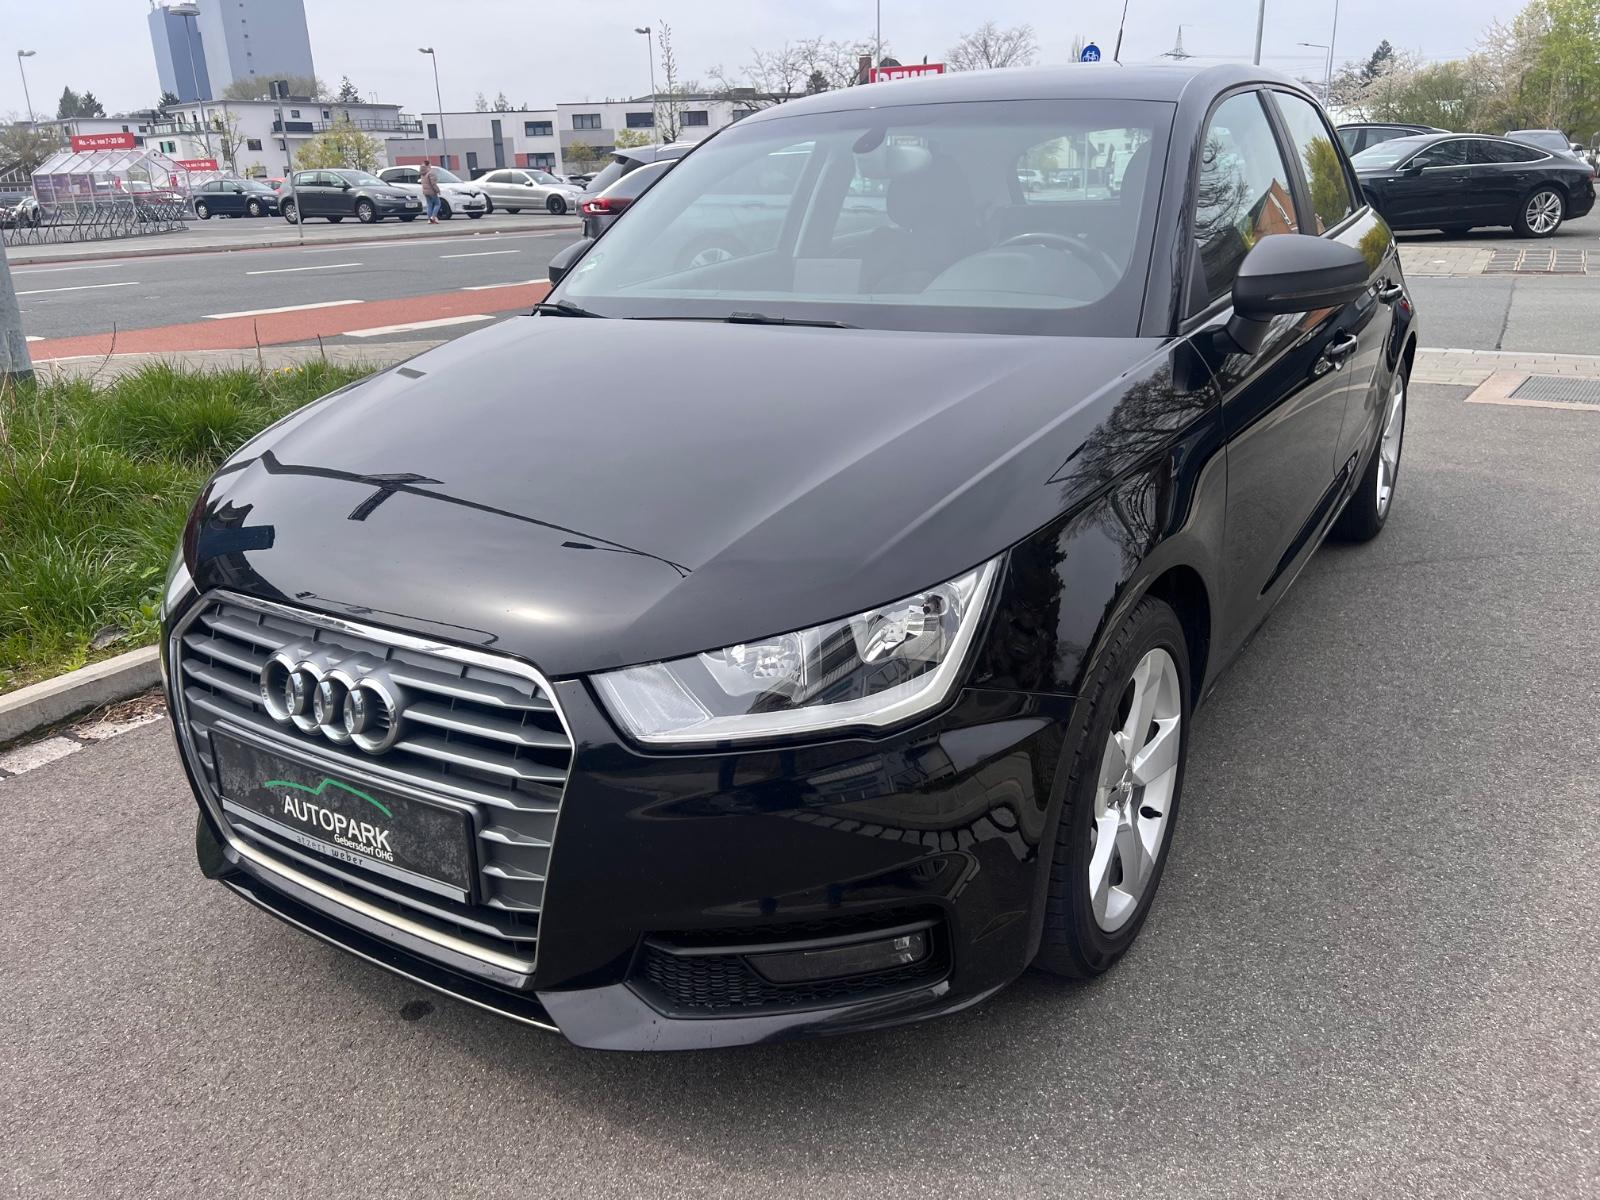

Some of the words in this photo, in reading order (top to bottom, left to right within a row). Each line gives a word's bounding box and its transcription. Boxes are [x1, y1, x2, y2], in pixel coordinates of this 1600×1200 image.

[284, 795, 392, 851] AUTOPARK
[331, 849, 363, 866] weber
[334, 834, 374, 856] Gebersdorf
[375, 848, 394, 862] OHG
